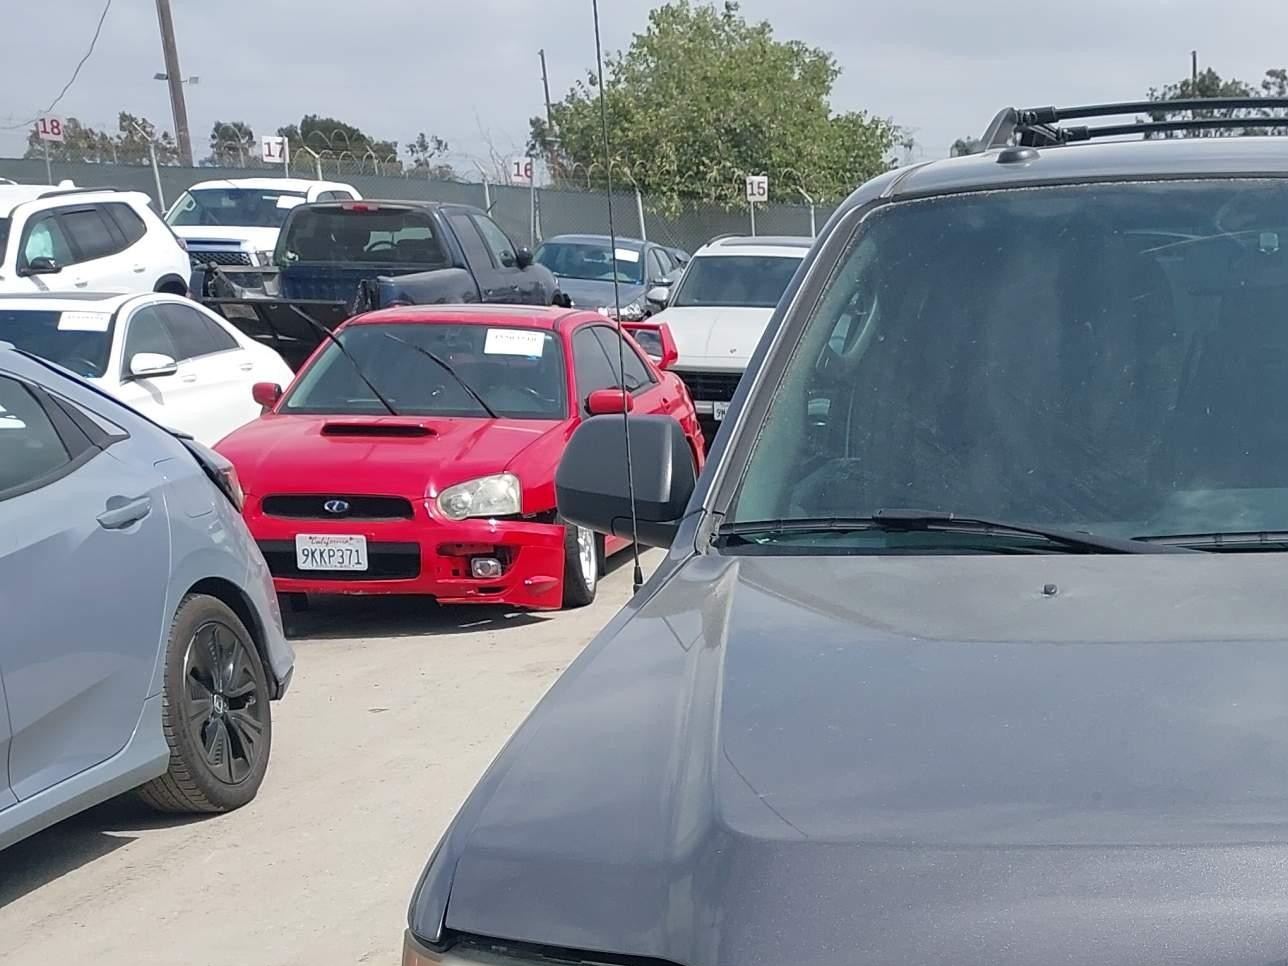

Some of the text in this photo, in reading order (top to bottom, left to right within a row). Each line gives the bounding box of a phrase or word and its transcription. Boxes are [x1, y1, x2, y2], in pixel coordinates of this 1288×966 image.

[39, 117, 62, 136] 18
[263, 141, 285, 158] 17
[513, 161, 534, 178] 16
[748, 180, 767, 197] 15
[301, 547, 362, 566] 9KKP371
